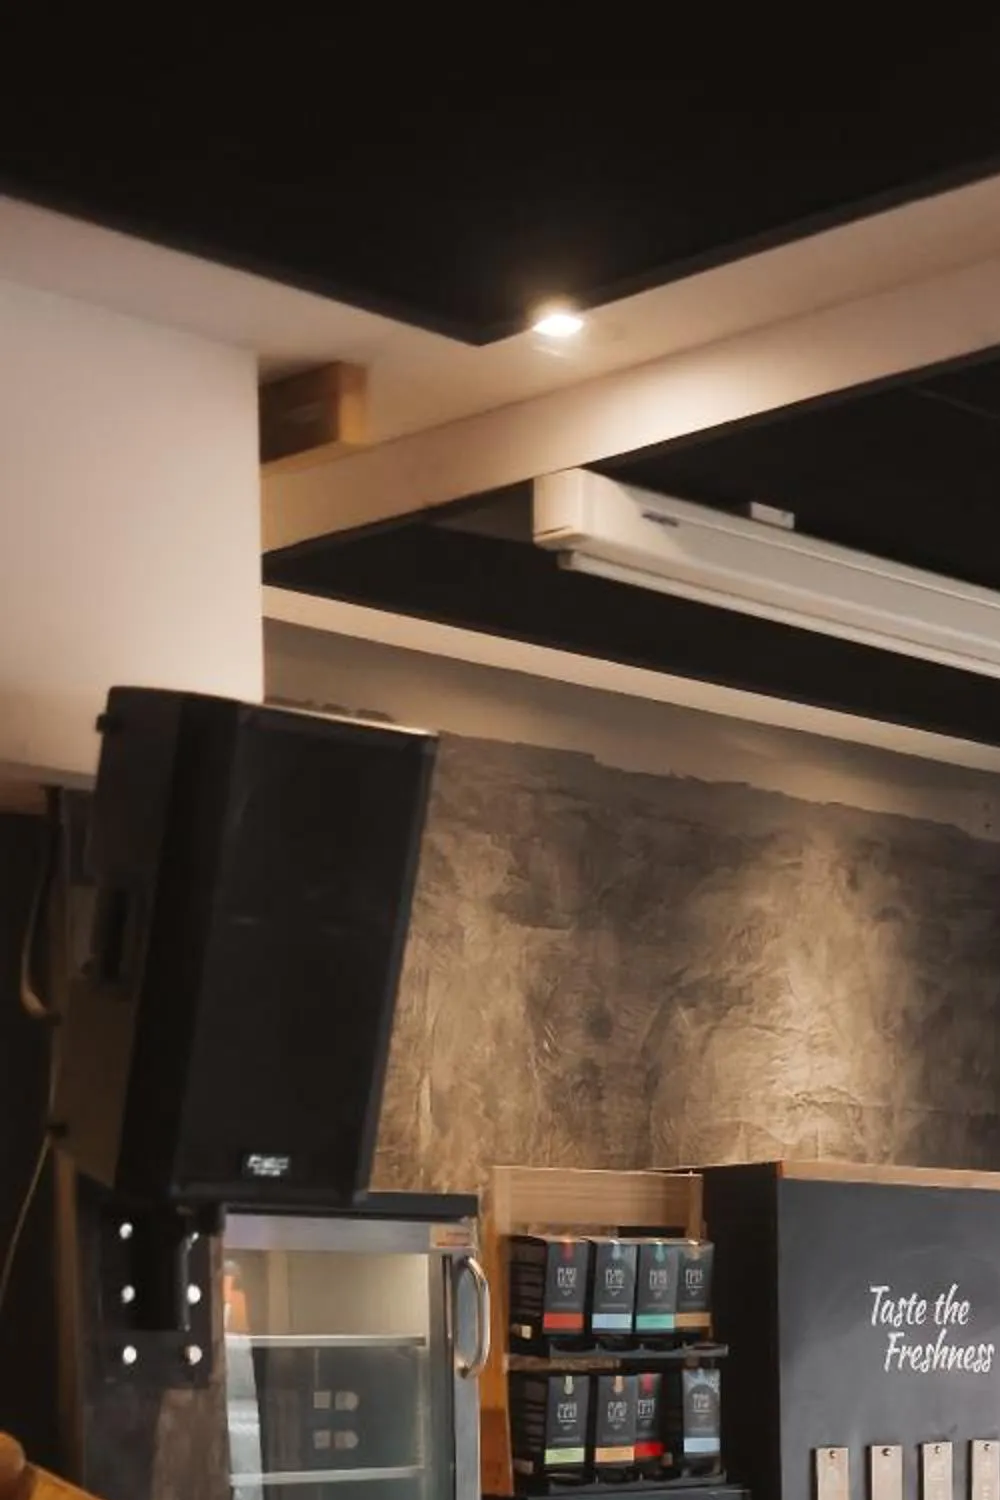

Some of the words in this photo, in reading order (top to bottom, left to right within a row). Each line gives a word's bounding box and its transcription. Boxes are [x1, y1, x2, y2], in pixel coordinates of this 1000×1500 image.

[870, 1285, 927, 1328] Taste
[934, 1283, 970, 1325] the
[884, 1327, 995, 1373] Freshness
